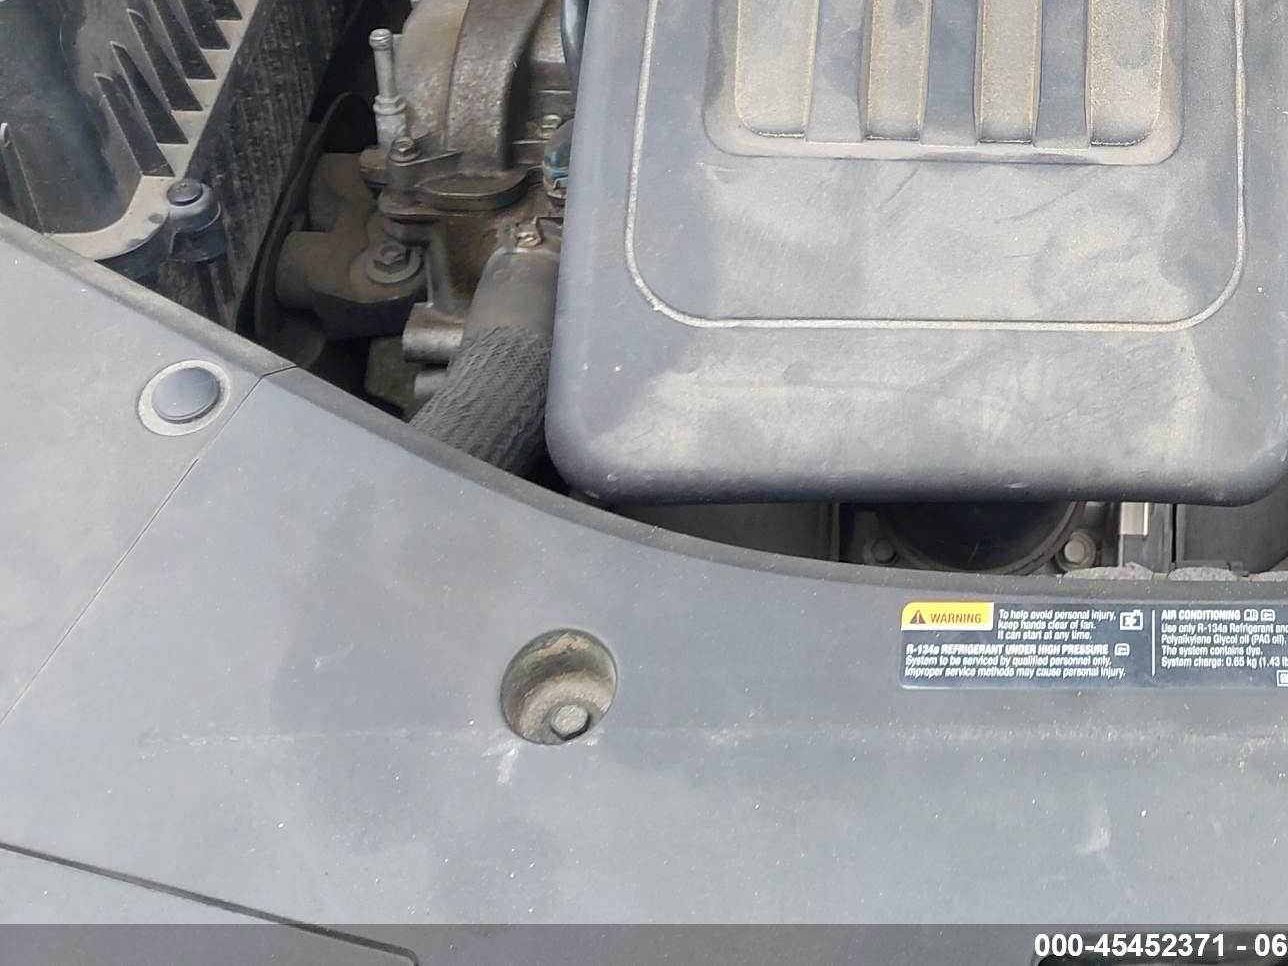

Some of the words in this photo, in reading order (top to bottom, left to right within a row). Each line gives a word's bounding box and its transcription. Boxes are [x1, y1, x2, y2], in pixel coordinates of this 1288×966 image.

[930, 613, 982, 624] WARNING
[999, 610, 1009, 620] To
[1011, 610, 1028, 621] help
[1030, 610, 1053, 620] avoid
[1054, 610, 1090, 622] personal
[1161, 610, 1176, 620] AIR
[1178, 610, 1240, 620] CONDITIONING
[998, 620, 1019, 631] keep
[1020, 620, 1046, 630] hands
[1048, 620, 1068, 630] clear
[1070, 620, 1078, 630] of
[1080, 620, 1096, 630] fan.
[1162, 624, 1177, 634] Use
[1179, 624, 1196, 635] only
[1198, 624, 1228, 634] R-134a
[1230, 624, 1274, 635] Refrigerant
[998, 631, 1004, 640] It
[1006, 631, 1021, 640] can
[1023, 631, 1042, 640] start
[1044, 631, 1053, 640] at
[1054, 631, 1070, 641] any
[1072, 631, 1092, 640] time.
[1213, 634, 1238, 646] Glycol
[1240, 634, 1250, 644] oil
[1251, 634, 1270, 644] (PAG
[906, 644, 940, 655] R-134a
[941, 644, 1004, 655] REFRIGERANT
[1005, 644, 1036, 655] UNDER
[1038, 644, 1061, 655] HIGH
[1062, 644, 1109, 655] PRESSURE
[1162, 645, 1177, 655] The
[1179, 645, 1208, 656] system
[1210, 645, 1244, 655] contains
[1246, 645, 1264, 656] dye.
[906, 656, 938, 667] System
[940, 656, 949, 666] to
[950, 656, 961, 666] be
[962, 656, 998, 666] serviced
[1000, 656, 1010, 667] by
[1012, 656, 1048, 667] qualified
[1050, 656, 1091, 667] personnel
[1092, 656, 1112, 667] only.
[1162, 656, 1192, 668] System
[1194, 656, 1224, 668] charge:
[1226, 656, 1245, 666] 0.65
[1247, 656, 1257, 668] kg
[1259, 656, 1280, 668] (1.43
[905, 667, 944, 679] Improper
[946, 667, 976, 677] service
[978, 667, 1014, 677] methods
[1016, 667, 1035, 679] may
[1036, 667, 1062, 677] cause
[1063, 667, 1100, 679] personal
